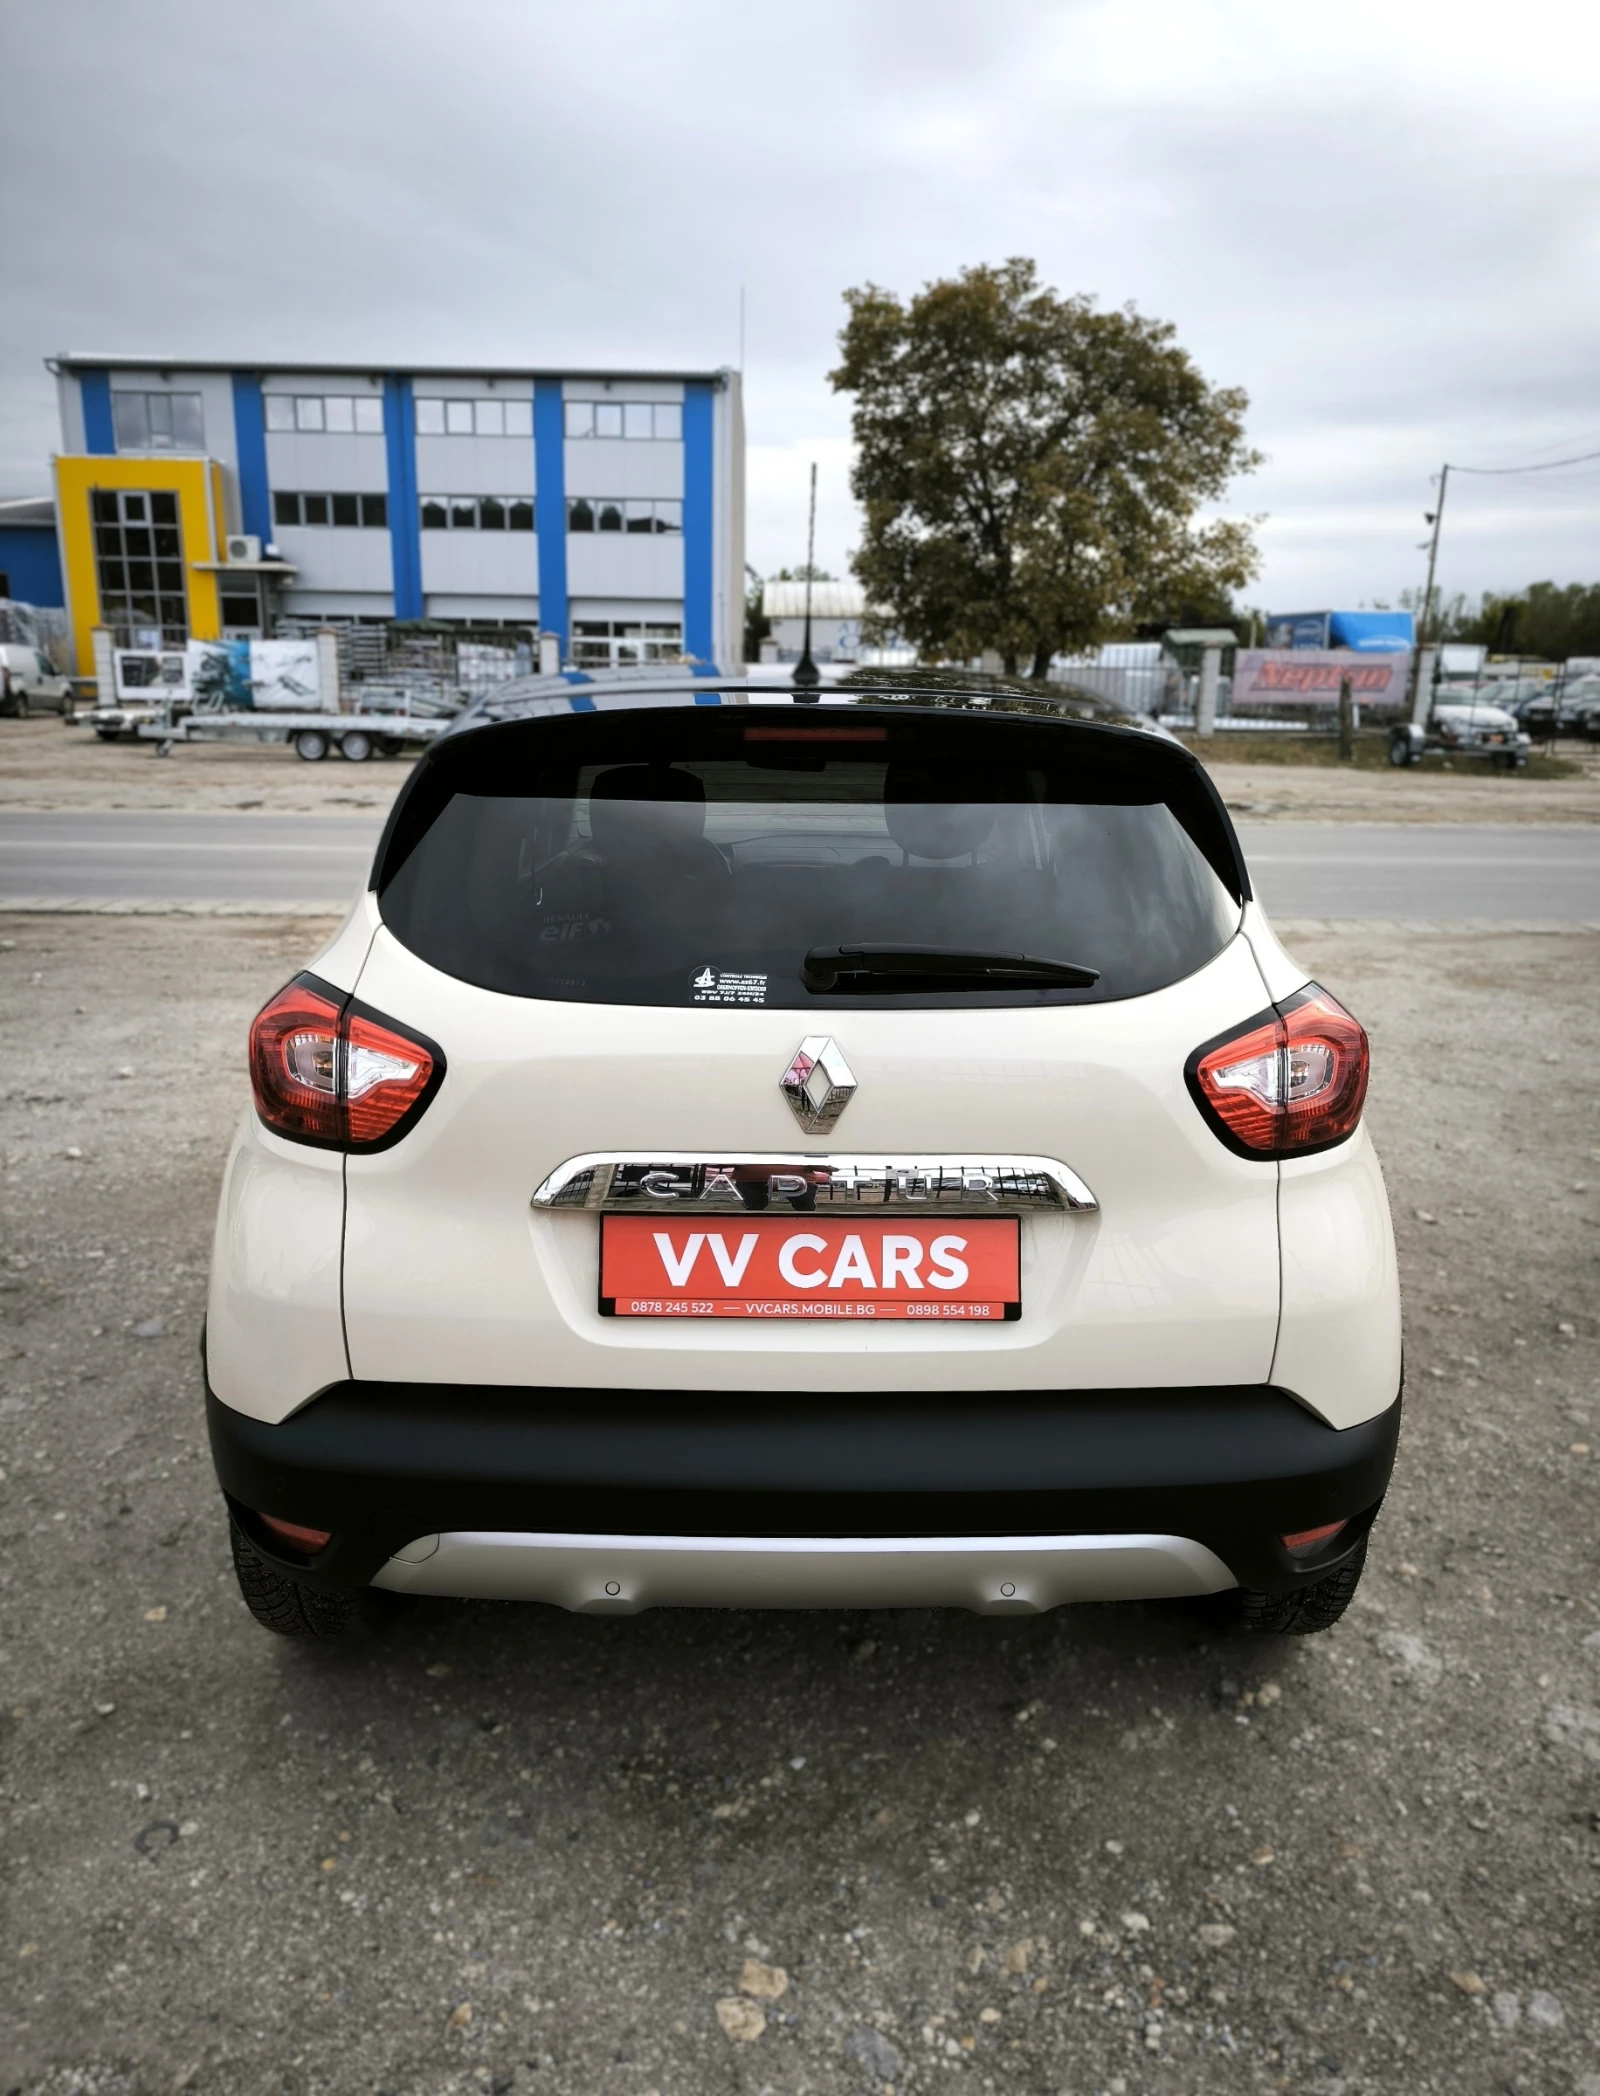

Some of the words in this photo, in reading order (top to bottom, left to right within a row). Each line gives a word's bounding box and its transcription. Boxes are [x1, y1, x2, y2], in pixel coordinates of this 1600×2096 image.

[540, 922, 585, 941] elf
[639, 1174, 999, 1201] CAPTUR
[652, 1232, 760, 1287] VV
[778, 1233, 970, 1290] CARS
[631, 1301, 663, 1312] 0878
[665, 1302, 688, 1313] 245
[691, 1302, 713, 1313] 522
[745, 1303, 876, 1315] VVCARS.MOBILE.BG
[906, 1304, 939, 1315] 0898
[942, 1304, 965, 1316] 554
[968, 1304, 990, 1316] 198
